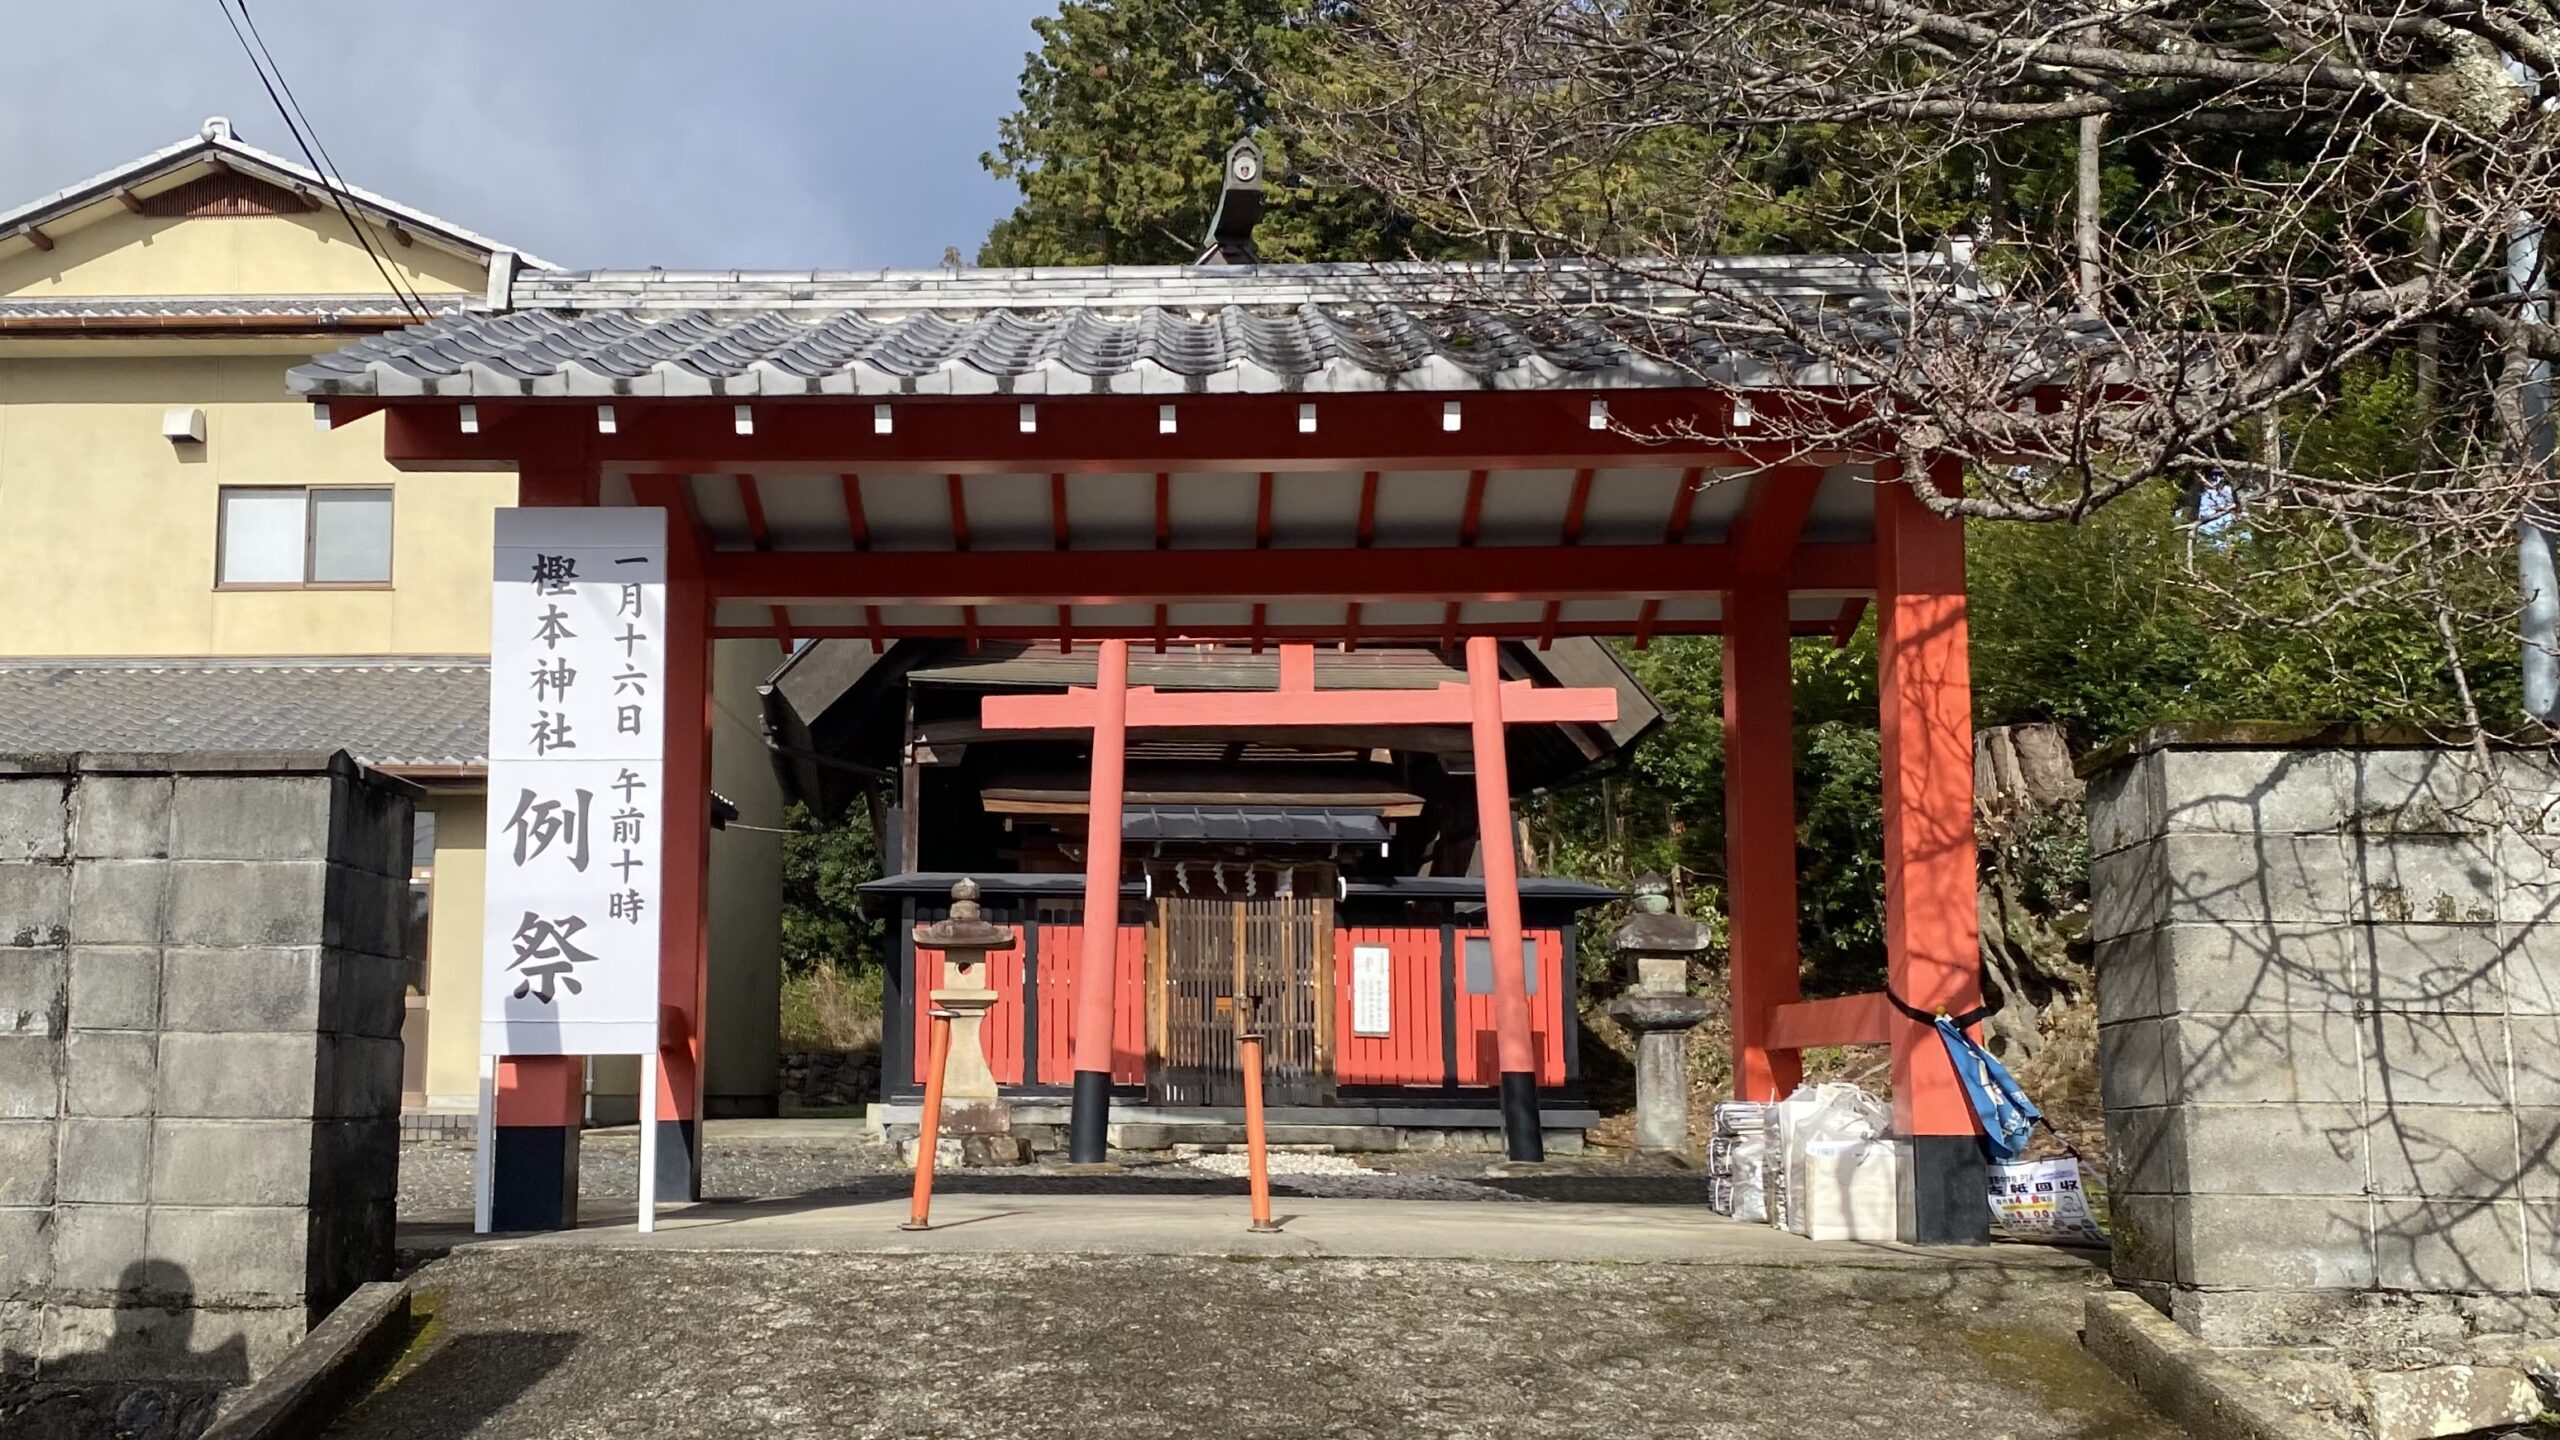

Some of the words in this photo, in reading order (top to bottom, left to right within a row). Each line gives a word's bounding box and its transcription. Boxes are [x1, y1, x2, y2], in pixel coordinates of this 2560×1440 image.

[529, 552, 580, 757] 樫本神社
[613, 556, 649, 737] 一月十六日
[502, 788, 599, 1004] 例祭
[608, 767, 647, 926] 午前十時
[1988, 1180, 2079, 1195] 古紙回収
